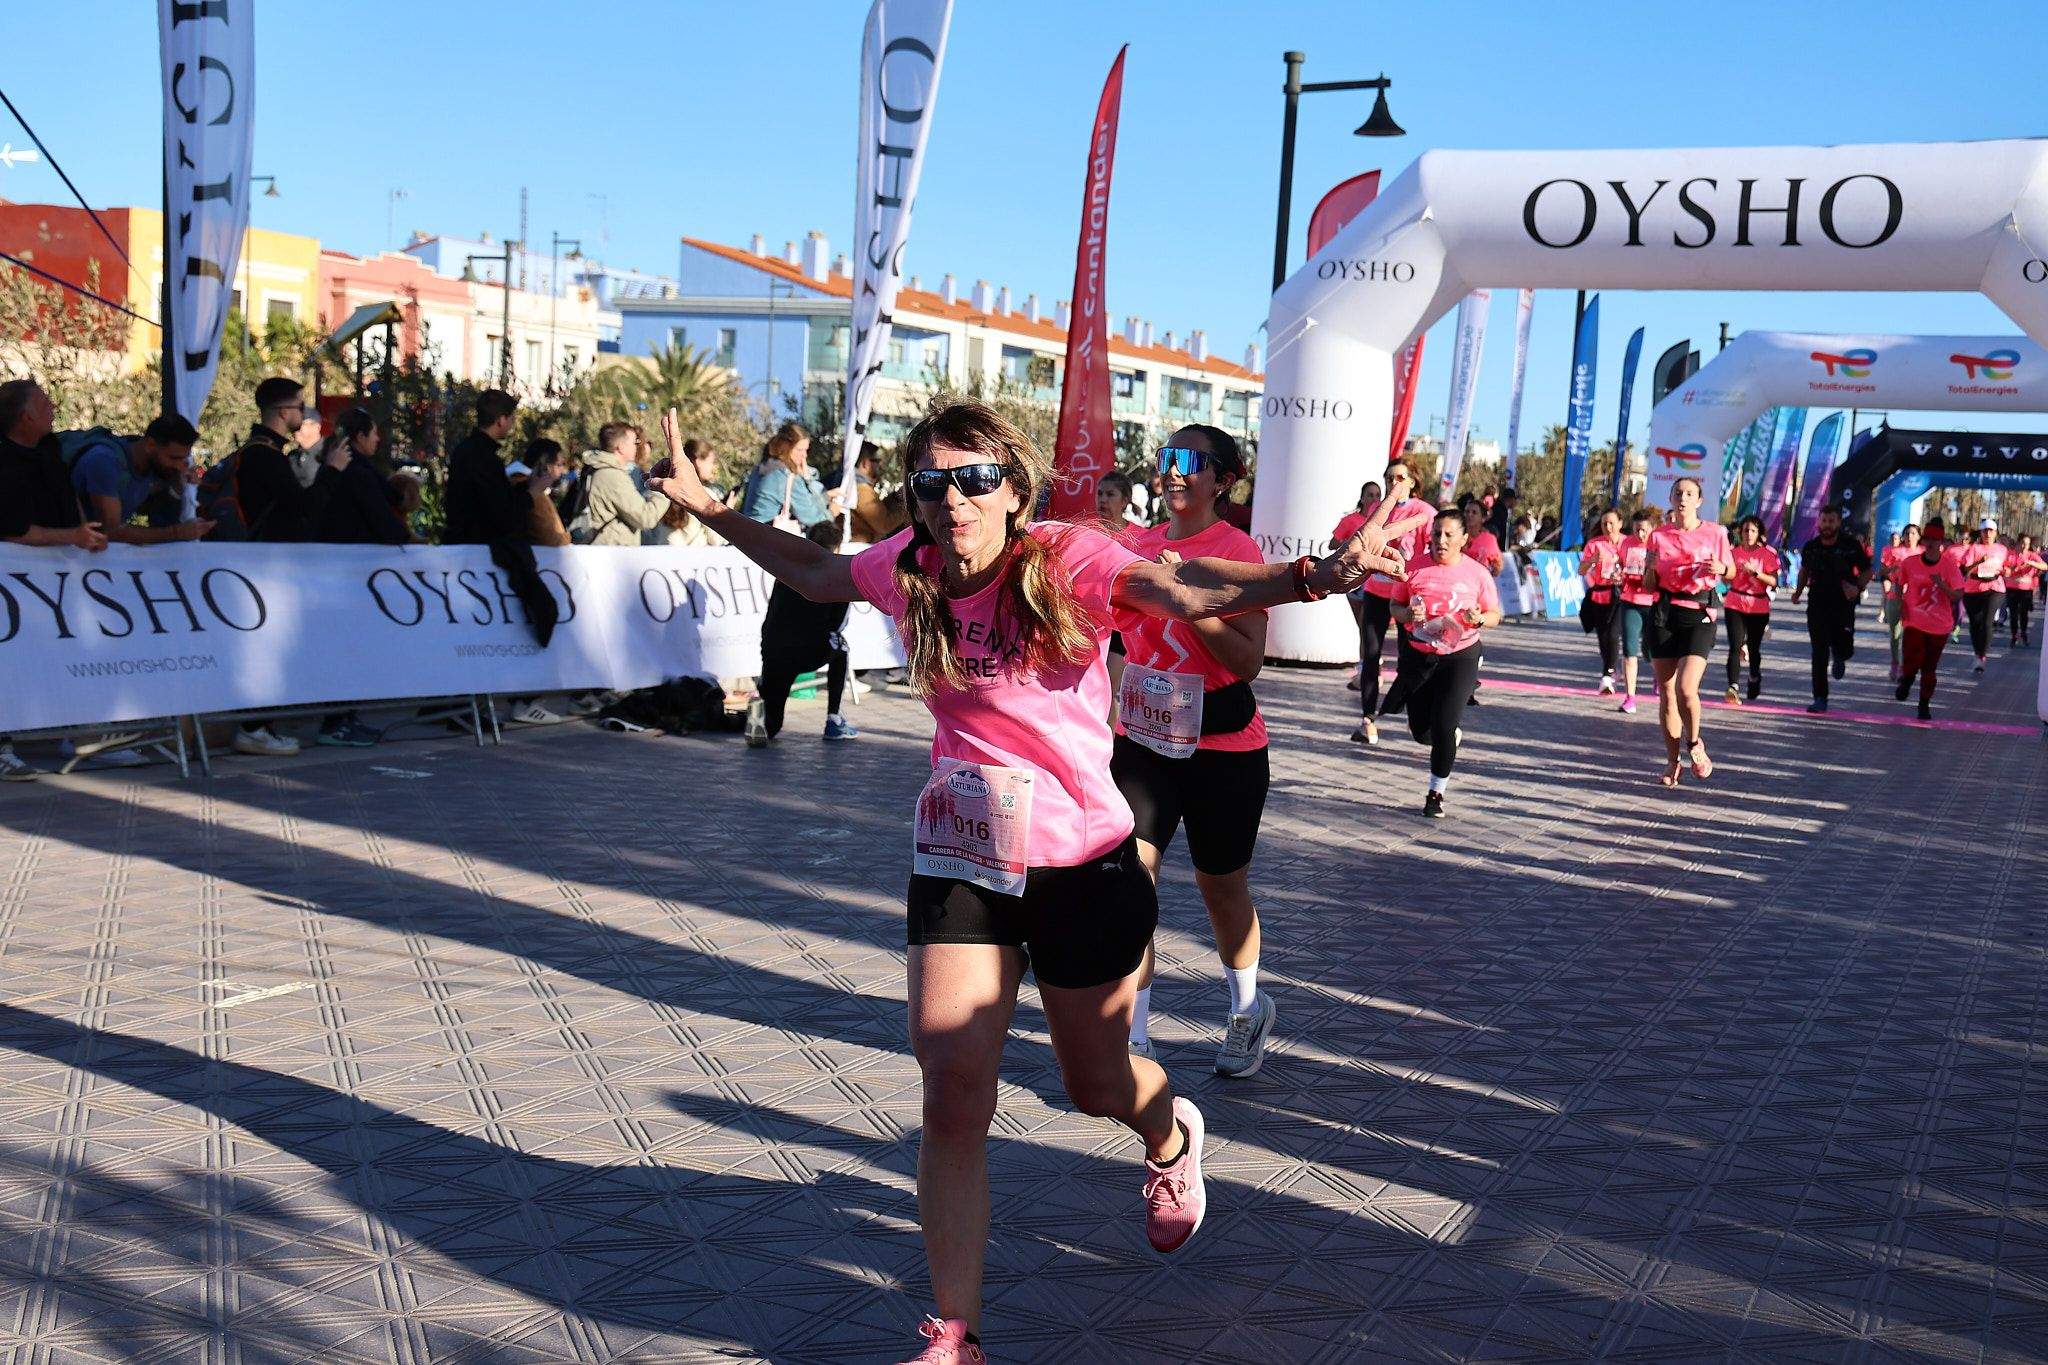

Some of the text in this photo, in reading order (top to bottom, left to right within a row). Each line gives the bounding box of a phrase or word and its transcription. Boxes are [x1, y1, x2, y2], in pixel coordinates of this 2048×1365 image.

[1522, 174, 1904, 249] OYSHO
[1317, 260, 1415, 283] OYSHO
[1808, 382, 1876, 392] TotalEnergies
[1948, 384, 2018, 395] TotalEnergies
[1265, 396, 1353, 421] OYSHO
[1911, 442, 2048, 460] VOLVO
[1143, 705, 1172, 724] 016
[949, 778, 988, 794] ASTURIANA
[954, 814, 990, 841] 016
[927, 859, 966, 872] OYSHO
[928, 846, 955, 856] CARRERA
[985, 858, 1011, 870] VALENCIA
